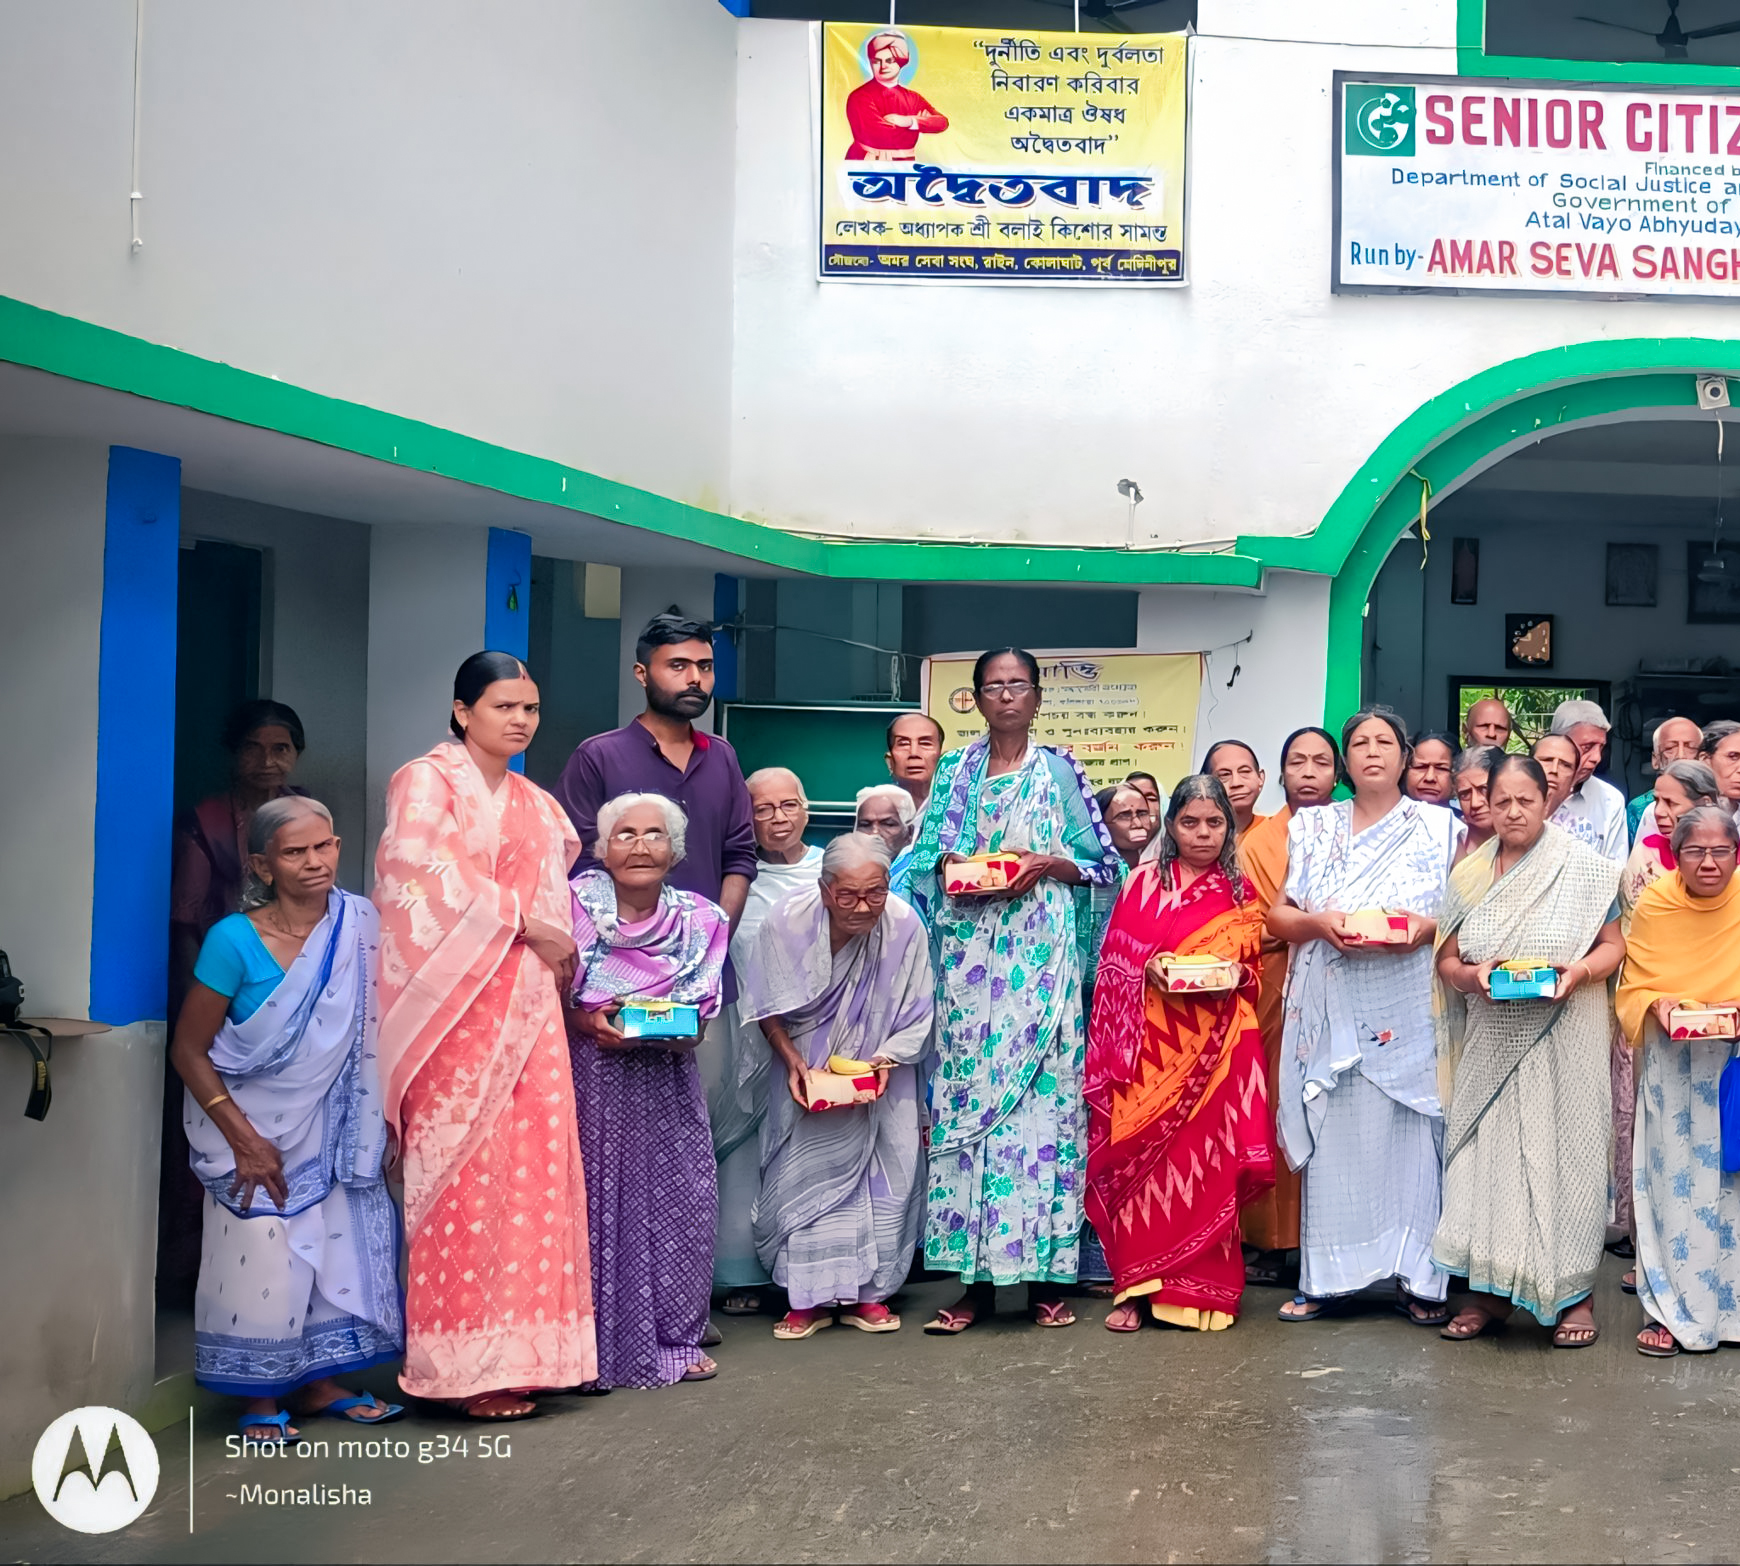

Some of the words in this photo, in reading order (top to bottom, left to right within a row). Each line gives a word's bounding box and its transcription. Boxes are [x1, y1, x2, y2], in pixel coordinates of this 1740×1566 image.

[1049, 48, 1089, 64] এবং
[1097, 41, 1164, 69] দুর্বলতা
[991, 69, 1059, 92] নিবারণ
[1067, 71, 1139, 94] করিবার
[1005, 105, 1074, 124] একমাত্র
[1082, 100, 1126, 124] ঔষধ
[1425, 95, 1609, 151] SENIOR
[1392, 168, 1520, 187] Department
[1528, 173, 1548, 187] of
[1560, 174, 1626, 191] Social
[1636, 177, 1711, 194] Justice
[1645, 162, 1725, 176] Financed
[848, 163, 1152, 210] অদ্বৈতবাদ
[1553, 193, 1697, 212] Government
[1706, 199, 1732, 214] of
[899, 222, 964, 238] অধ্যাপক
[968, 215, 991, 239] শ্রী
[997, 219, 1044, 241] বলাই
[1050, 216, 1113, 241] কিশোর
[1118, 223, 1167, 242] সামন্ত
[1525, 211, 1570, 229] Atal
[1579, 212, 1631, 234] Vayo
[878, 255, 909, 267] অমর
[915, 255, 944, 267] সেবা
[1350, 241, 1389, 265] Run
[1426, 239, 1520, 276] AMAR
[1530, 241, 1620, 279] SEVA
